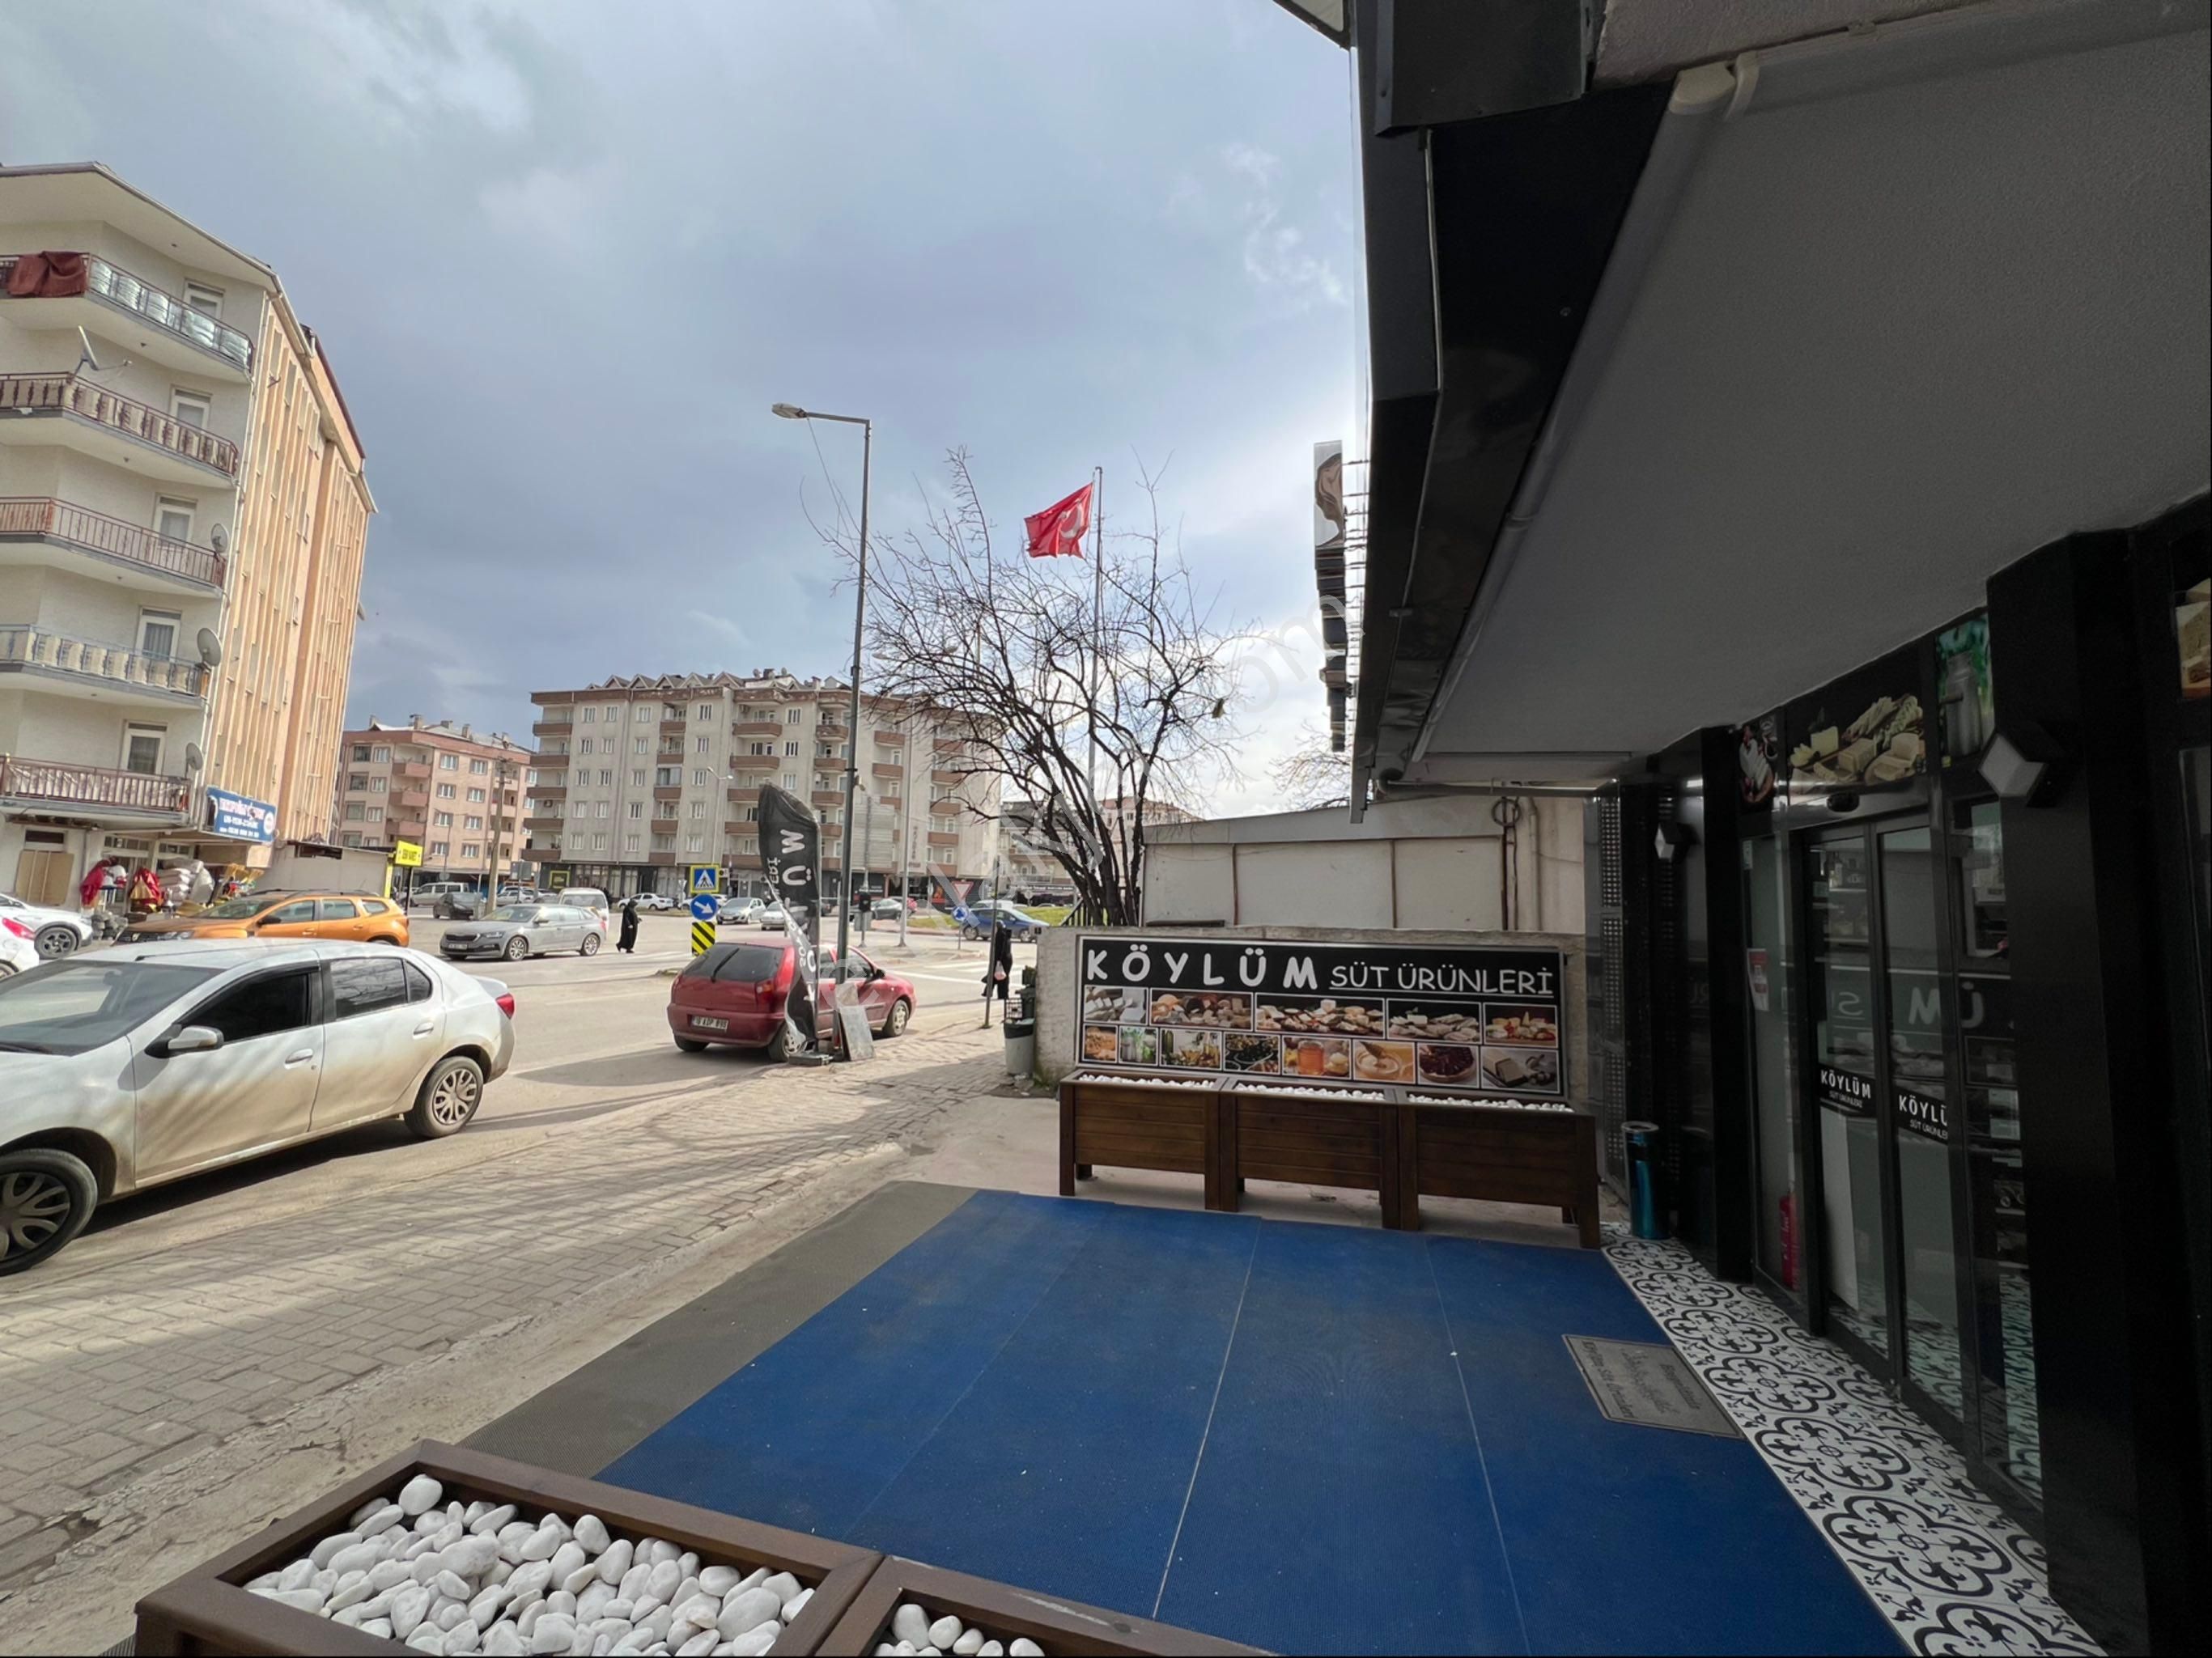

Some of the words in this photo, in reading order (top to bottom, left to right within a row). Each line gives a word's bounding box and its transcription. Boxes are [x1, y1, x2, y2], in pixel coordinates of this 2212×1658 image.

[1087, 943, 1318, 990] KÖYLÜM
[1331, 961, 1390, 987] SÜT
[1398, 963, 1553, 994] ÜRÜNLERİ
[1821, 1069, 1871, 1099] KÖYLÜM
